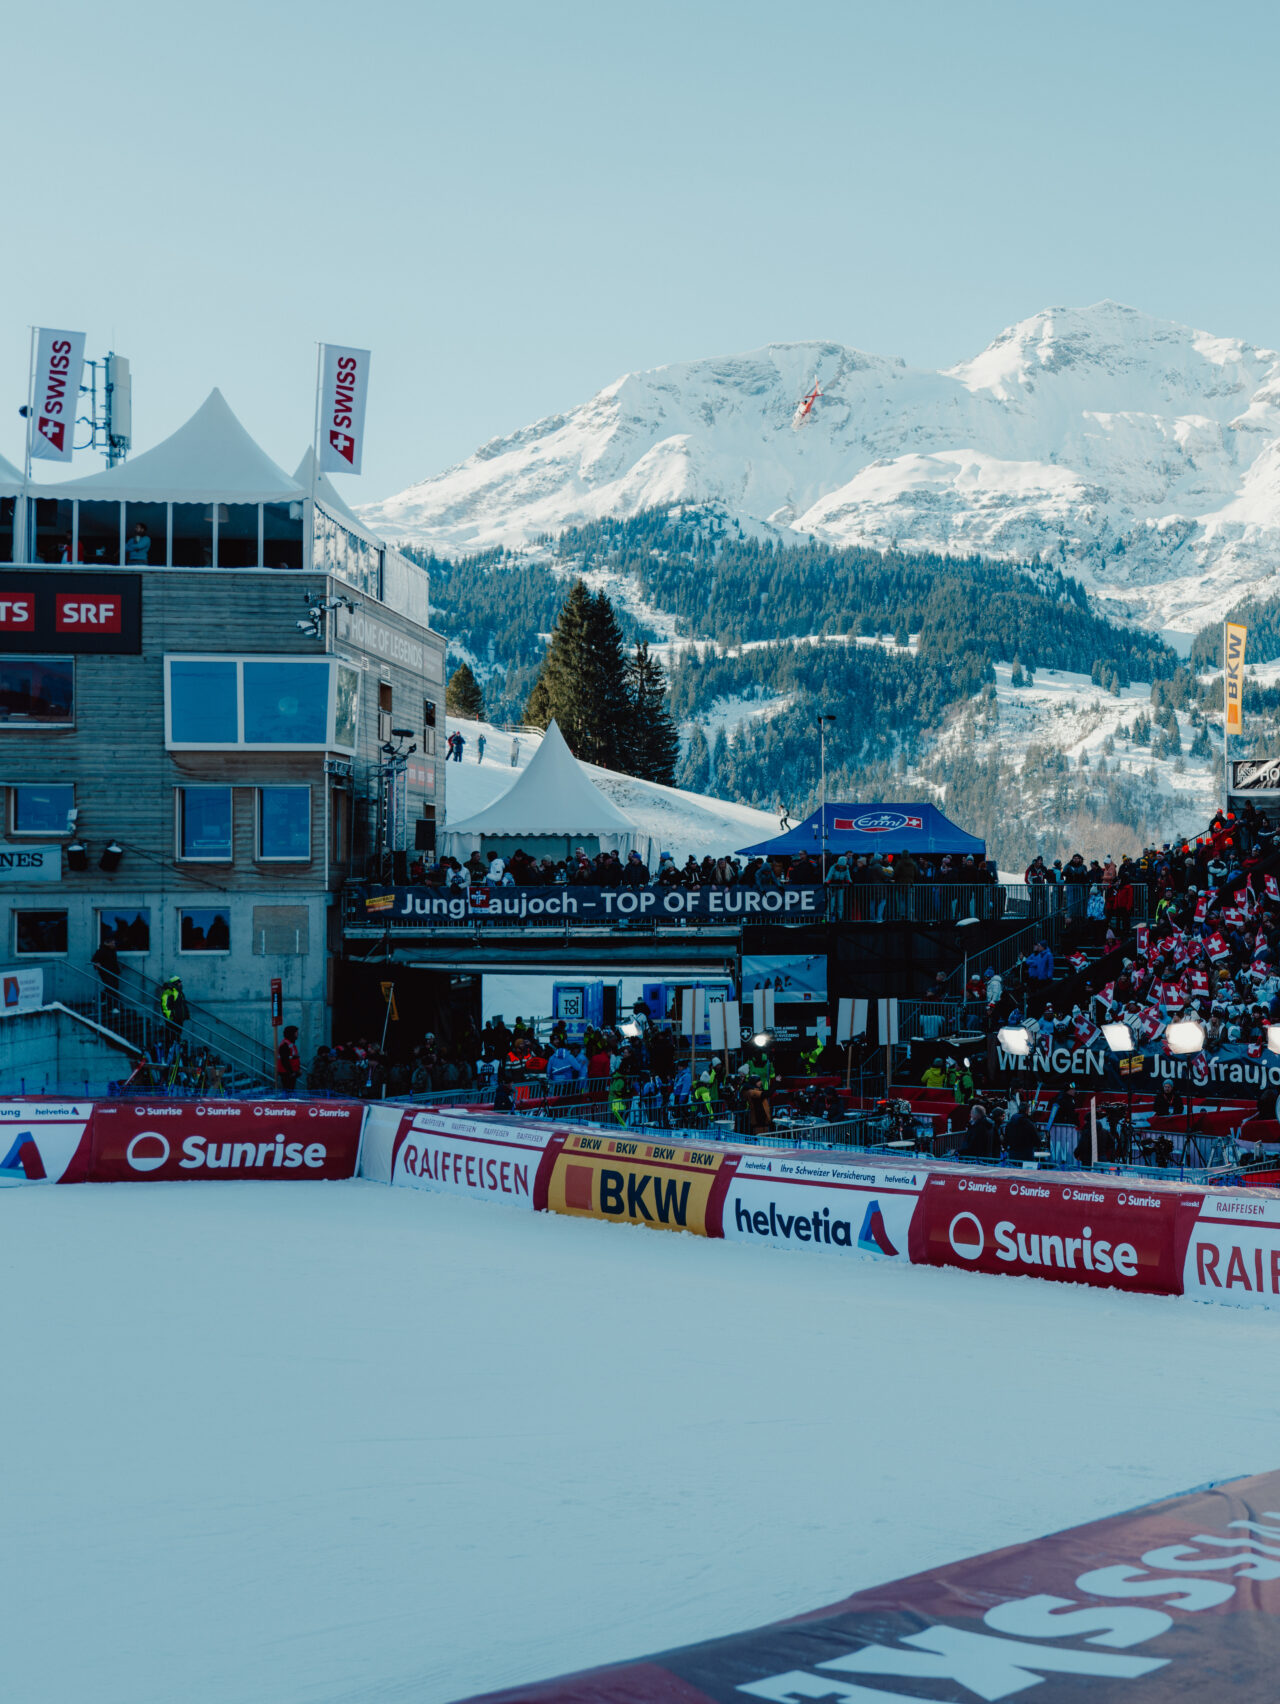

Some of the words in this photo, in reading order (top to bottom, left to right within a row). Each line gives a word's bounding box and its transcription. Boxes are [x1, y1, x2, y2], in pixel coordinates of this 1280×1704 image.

[44, 340, 71, 414] SWISS
[333, 357, 357, 428] SWISS
[62, 603, 115, 623] SRF
[351, 615, 378, 650] HOME
[378, 629, 390, 655] OF
[390, 632, 423, 669] LEGENDS
[1227, 633, 1242, 699] BKW
[857, 816, 902, 828] Emmi
[401, 891, 578, 919] Jungaujoch
[600, 892, 656, 913] TOP
[663, 891, 701, 913] OF
[709, 890, 816, 913] EUROPE
[996, 1045, 1105, 1075] WENGEN
[147, 1107, 183, 1116] Sunrise
[207, 1107, 241, 1116] Sunrise
[264, 1108, 296, 1116] Sunrise
[319, 1109, 350, 1117] Sunrise
[421, 1117, 445, 1128] RAIFFEISEN
[451, 1123, 477, 1133] RAIFFEISEN
[483, 1127, 510, 1138] RAIFFEISEN
[516, 1132, 543, 1143] RAIFFEISEN
[580, 1138, 602, 1150] BKW
[615, 1142, 638, 1155] BKW
[178, 1133, 327, 1169] Sunrise
[652, 1147, 675, 1160] BKW
[690, 1152, 714, 1166] BKW
[403, 1144, 529, 1197] RAIFFEISEN
[745, 1161, 766, 1170] helvetia
[780, 1163, 794, 1174] Ihre
[794, 1166, 830, 1177] Schweizer
[831, 1169, 876, 1184] Versicherung
[884, 1175, 910, 1184] helvetia
[967, 1180, 997, 1193] Sunrise
[1020, 1185, 1050, 1198] Sunrise
[600, 1169, 691, 1226] BKW
[1072, 1190, 1105, 1203] Sunrise
[1127, 1195, 1161, 1208] Sunrise
[1216, 1202, 1265, 1215] RAIFFEISEN
[735, 1198, 852, 1247] helvetia
[994, 1220, 1139, 1277] Sunrise
